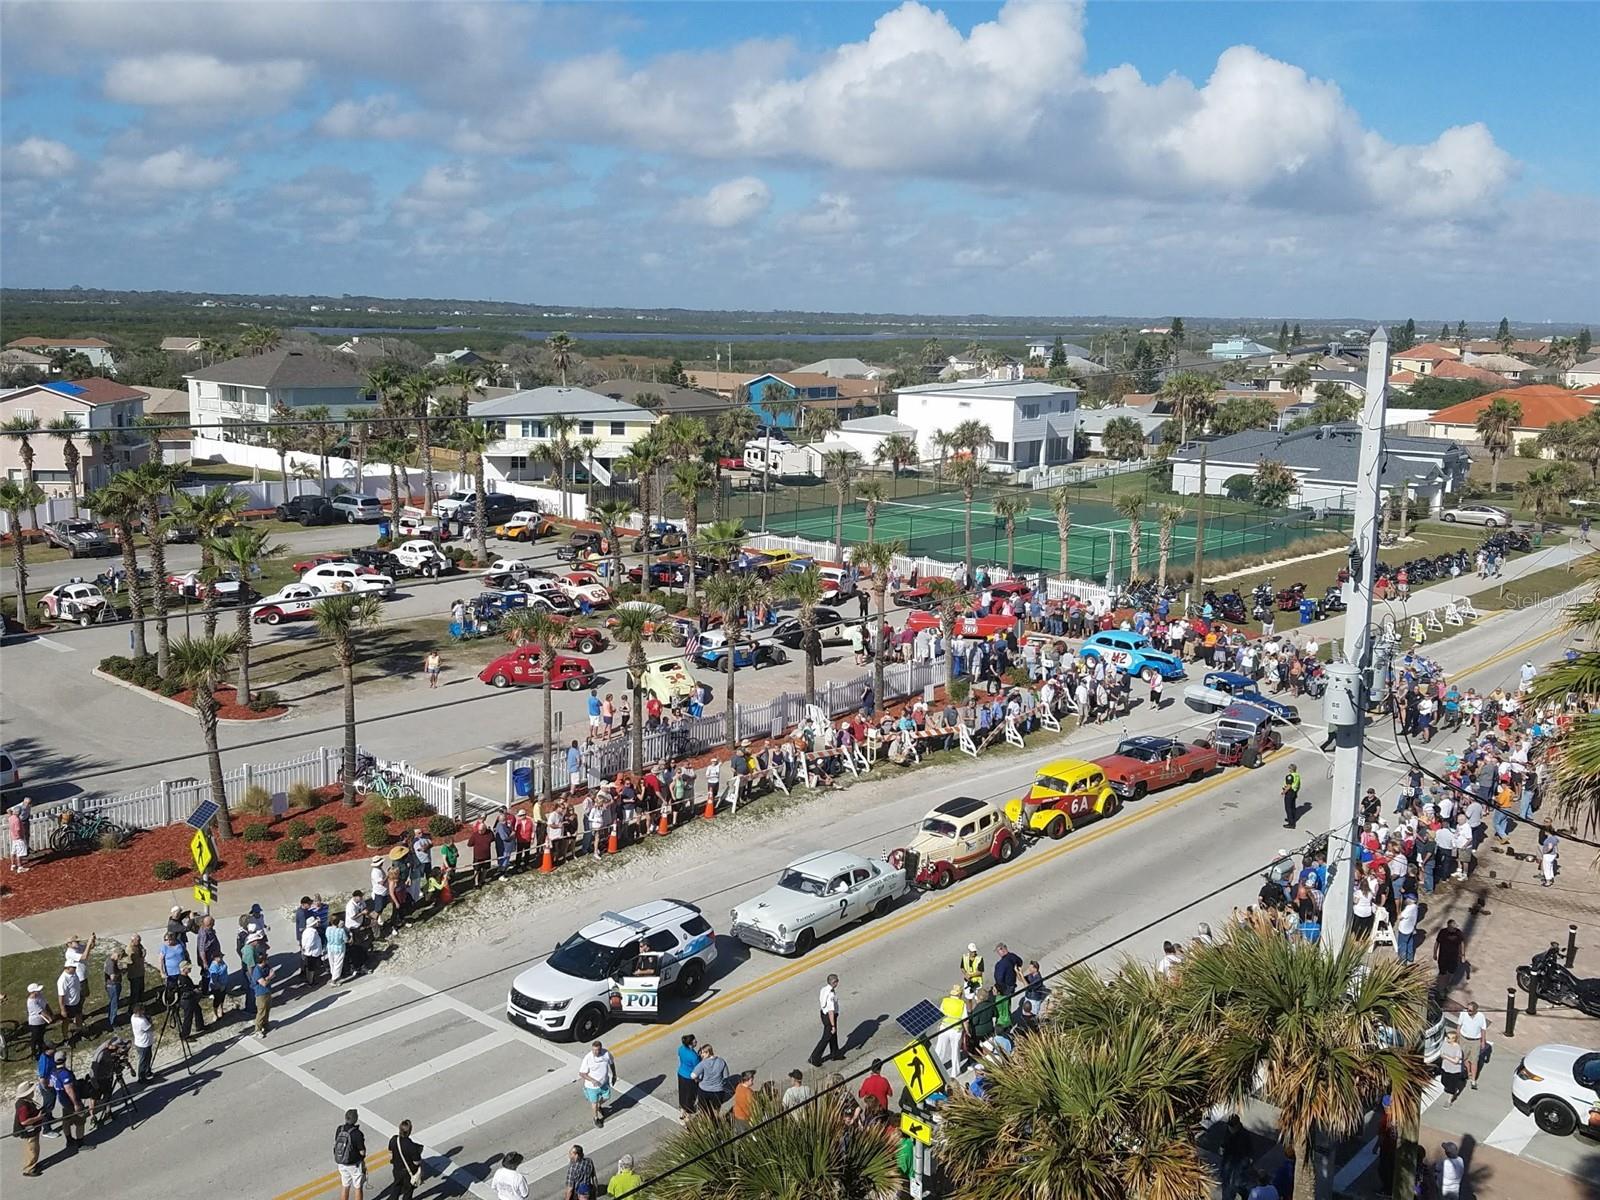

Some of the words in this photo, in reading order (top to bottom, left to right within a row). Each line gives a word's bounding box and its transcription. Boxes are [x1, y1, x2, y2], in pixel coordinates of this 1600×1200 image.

[591, 589, 608, 599] 63
[834, 626, 841, 636] 3
[1071, 795, 1089, 814] 6A
[839, 898, 849, 920] 2
